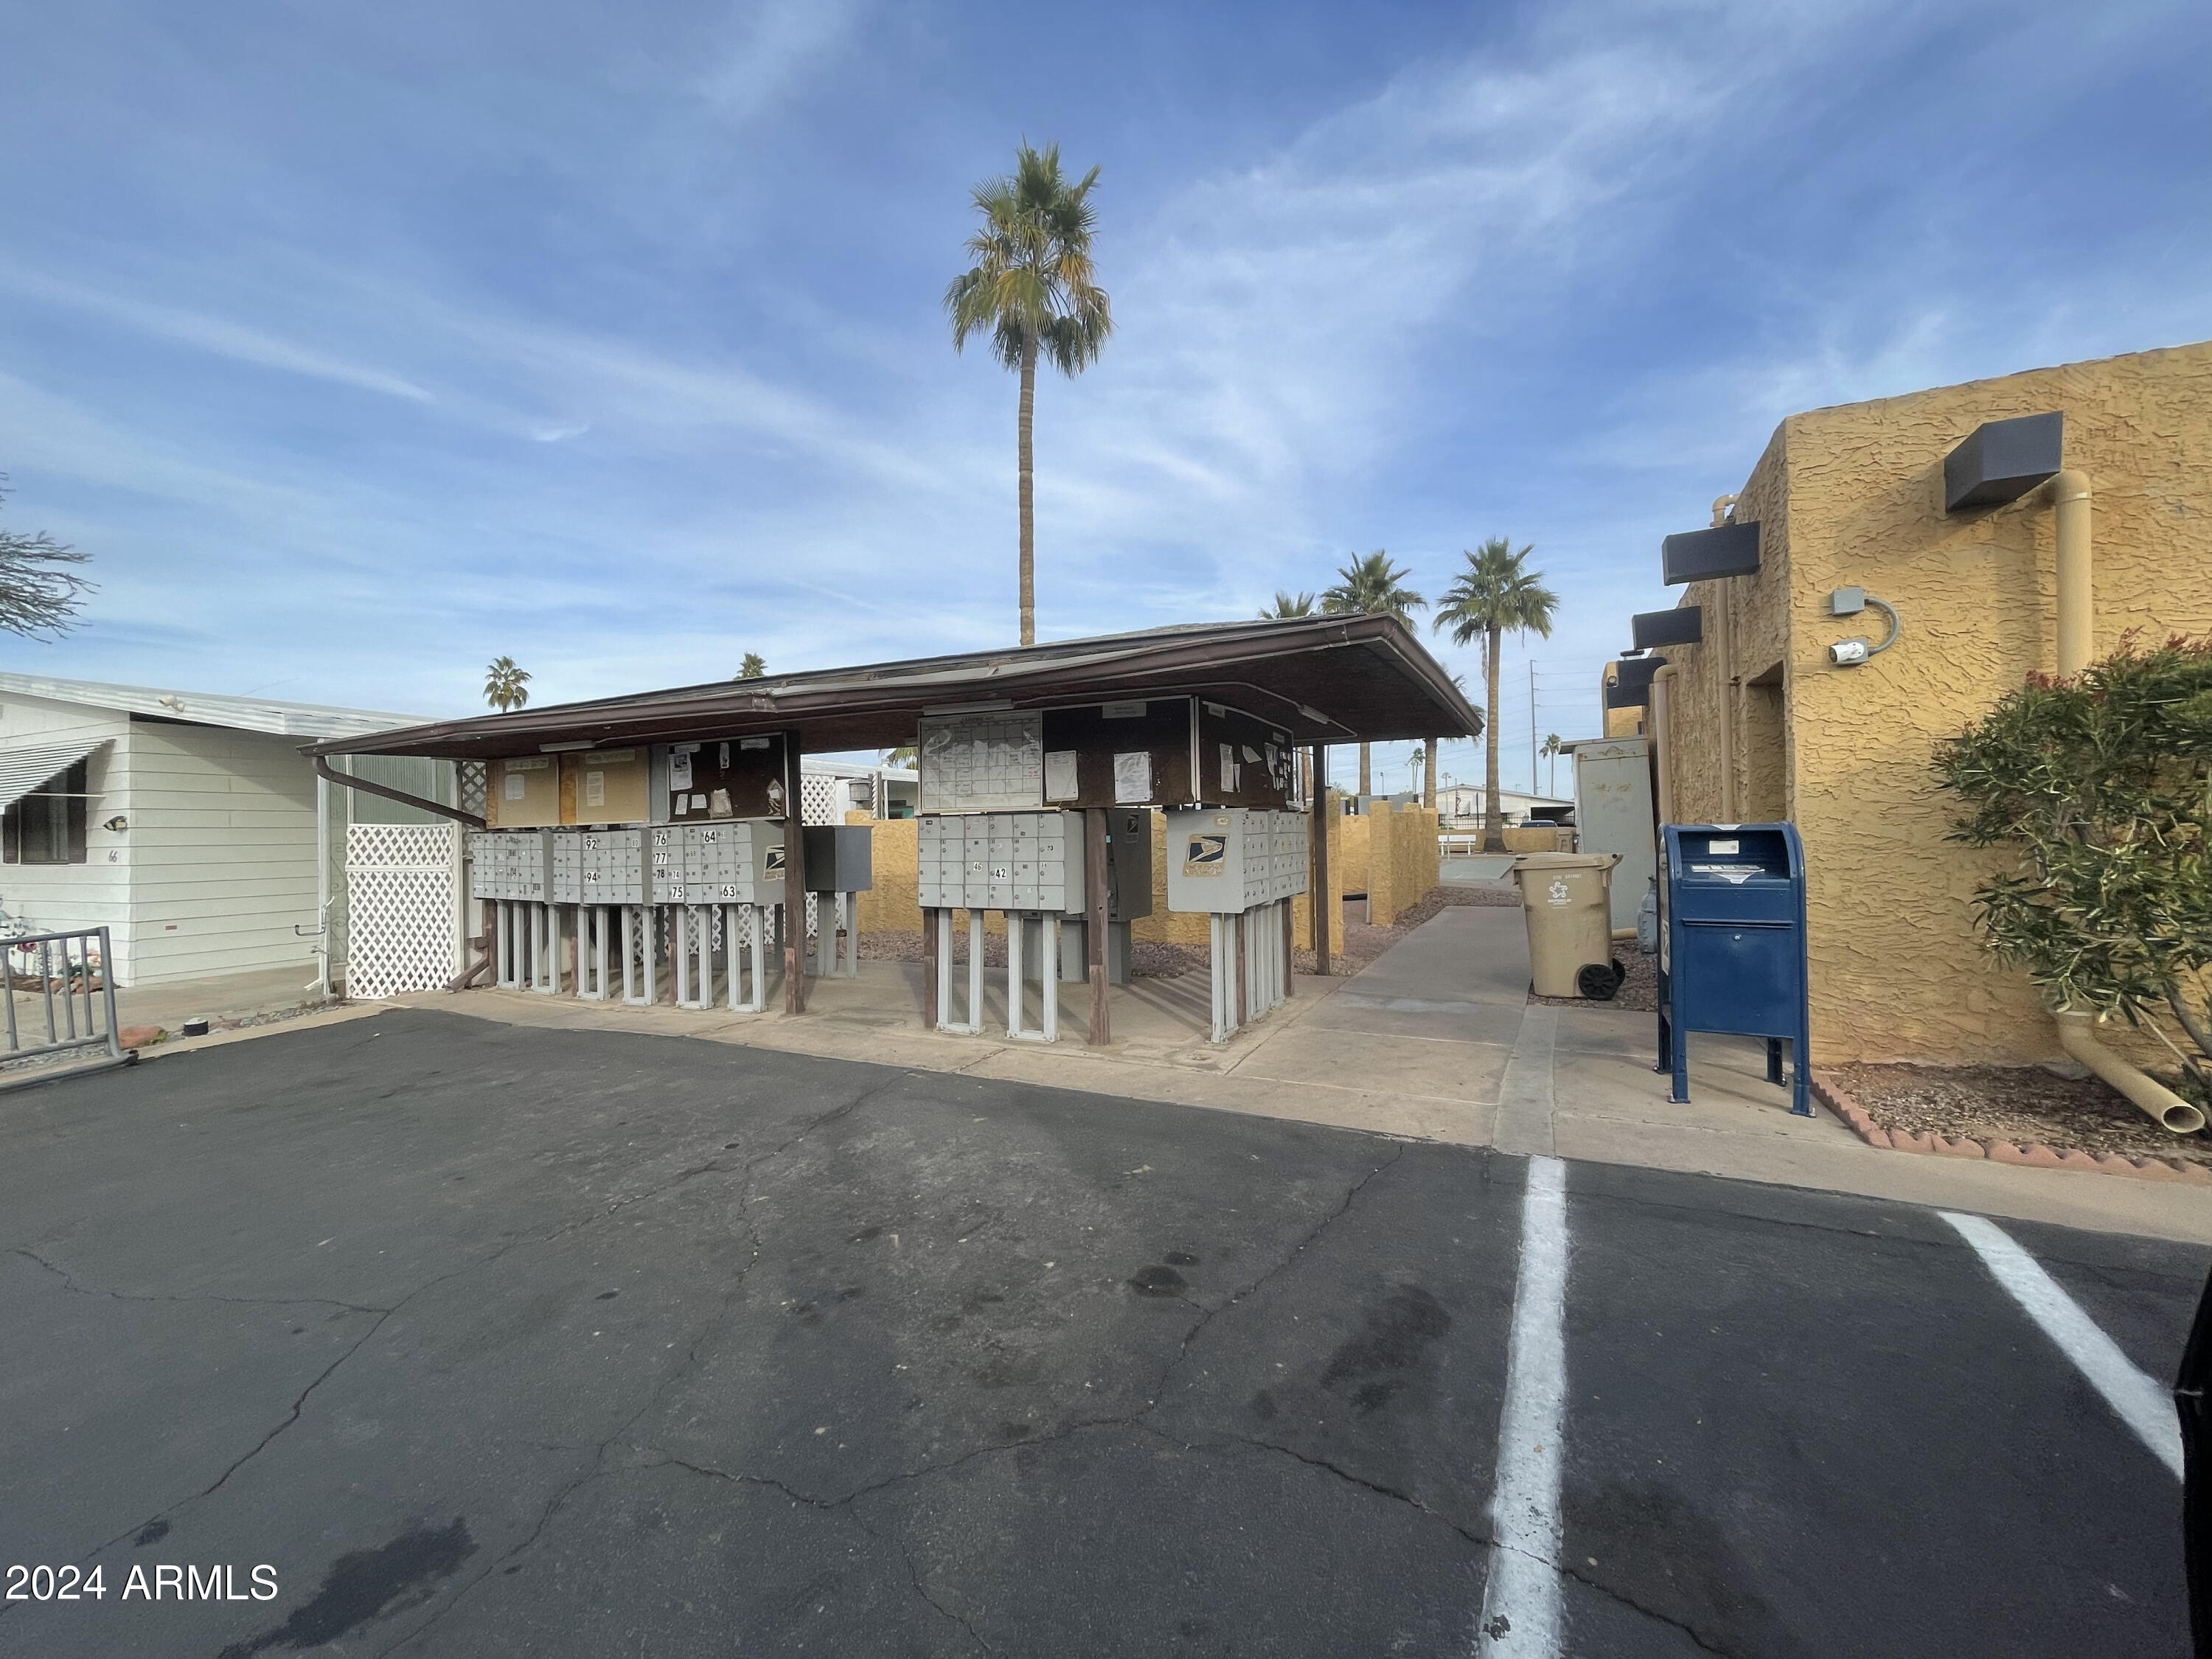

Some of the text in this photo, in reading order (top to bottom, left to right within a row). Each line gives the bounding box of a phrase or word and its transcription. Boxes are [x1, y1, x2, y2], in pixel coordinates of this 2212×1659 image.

[655, 835, 666, 845] 76
[704, 831, 715, 842] 64
[586, 840, 597, 849] 92
[108, 850, 117, 863] 66
[655, 852, 666, 863] 77
[586, 872, 597, 883] 94
[656, 869, 665, 879] 78
[995, 869, 1006, 878] 42
[672, 886, 683, 897] 75
[723, 886, 735, 897] 63
